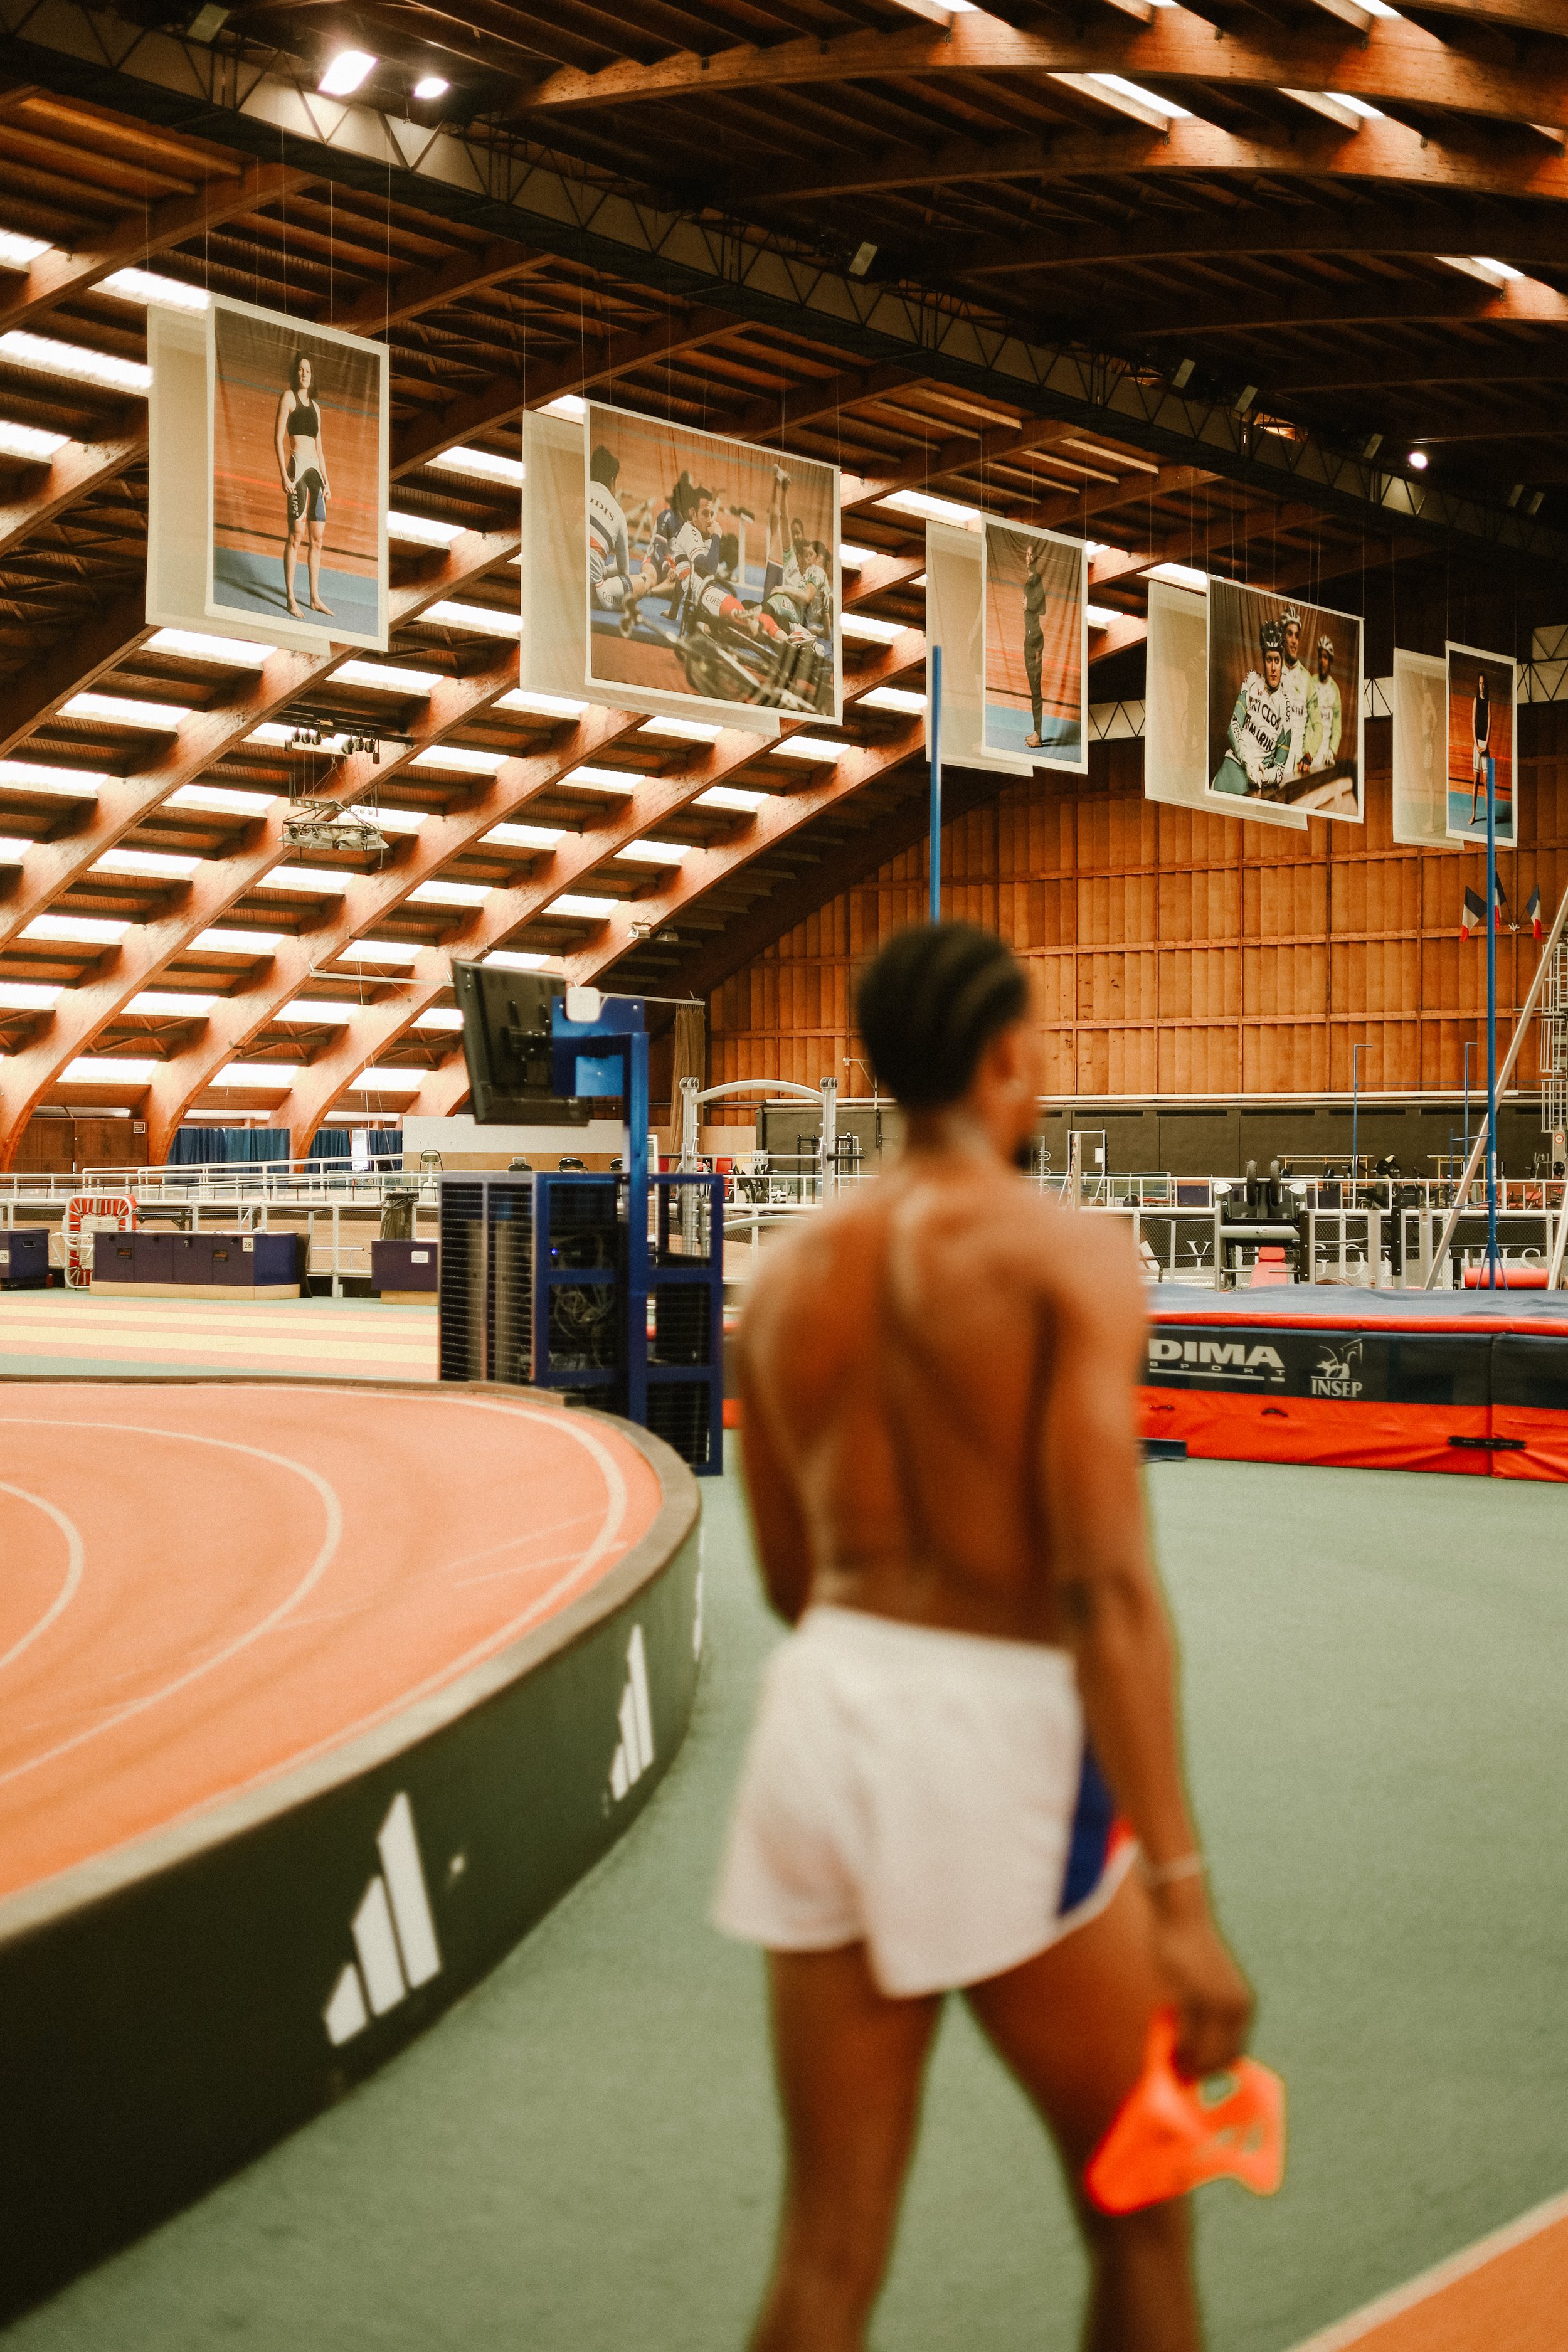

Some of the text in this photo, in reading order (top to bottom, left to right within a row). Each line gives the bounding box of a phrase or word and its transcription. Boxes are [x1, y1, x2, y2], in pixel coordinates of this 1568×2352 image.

[1149, 1338, 1285, 1368] DIMA
[1149, 1361, 1285, 1375] SPORT
[1311, 1379, 1363, 1397] INSEP
